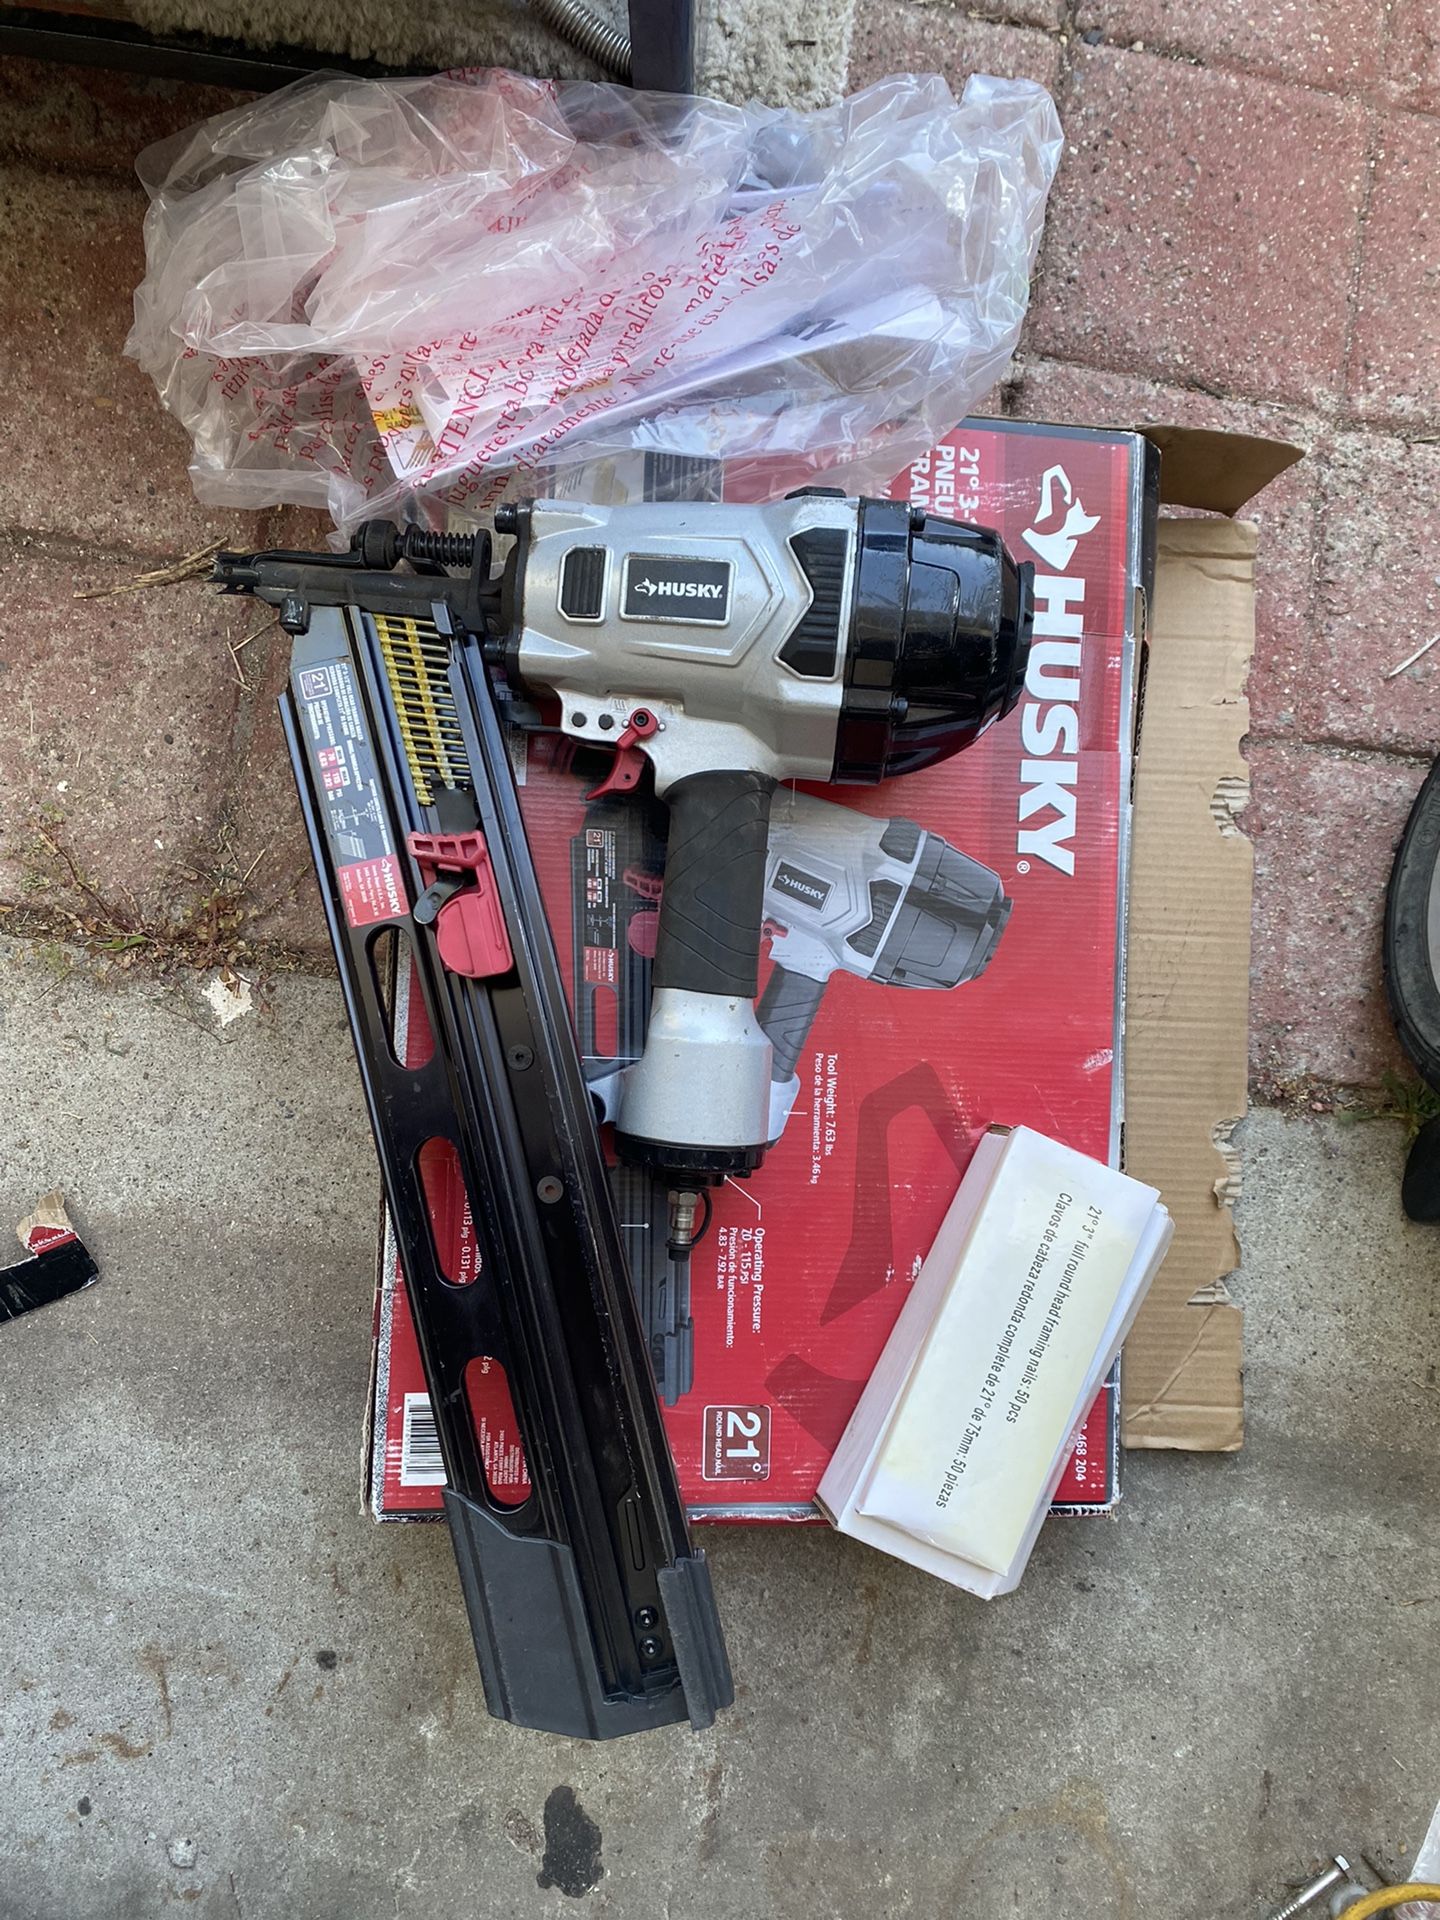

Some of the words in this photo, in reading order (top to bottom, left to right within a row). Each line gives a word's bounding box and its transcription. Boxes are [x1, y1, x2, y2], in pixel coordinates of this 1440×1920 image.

[619, 367, 656, 388] No
[959, 446, 980, 488] 21°
[934, 445, 956, 518] PNEU
[657, 581, 723, 599] HUSKY
[1017, 575, 1085, 877] HUSKY
[384, 873, 401, 913] HUSKY
[790, 879, 825, 900] HUSKY
[814, 1053, 824, 1073] Peso
[827, 1053, 838, 1075] Tool
[814, 1075, 824, 1086] de
[814, 1088, 823, 1096] la
[824, 1077, 837, 1118] Weight:
[813, 1098, 823, 1153] herramienta:
[825, 1121, 836, 1143] 7.63
[825, 1144, 833, 1155] lbs
[812, 1155, 821, 1175] 3.46
[810, 1175, 819, 1184] kg
[1048, 1193, 1073, 1229] Clavos
[1087, 1205, 1102, 1226] 21°
[719, 1226, 727, 1247] 4.83
[728, 1227, 738, 1259] Presión
[741, 1228, 752, 1241] 70
[1043, 1228, 1058, 1243] de
[461, 1246, 471, 1269] 0.131
[741, 1252, 751, 1269] 115
[751, 1227, 765, 1281] Operating
[1028, 1242, 1050, 1280] cabeza
[1071, 1240, 1089, 1261] full
[717, 1254, 727, 1273] 7.92
[728, 1262, 737, 1273] de
[740, 1269, 749, 1284] PSI
[1059, 1258, 1079, 1292] round
[726, 1275, 737, 1348] funcionamiento:
[752, 1284, 764, 1333] Pressure:
[1011, 1279, 1036, 1323] redonda
[1048, 1290, 1070, 1319] head
[991, 1323, 1018, 1373] complete
[1029, 1317, 1059, 1359] framing
[985, 1373, 1000, 1387] de
[1020, 1358, 1040, 1389] nails:
[980, 1387, 996, 1409] 21°
[1014, 1389, 1030, 1404] 50
[971, 1407, 987, 1422] de
[1006, 1401, 1022, 1424] pcs
[726, 1410, 762, 1472] 21°
[956, 1422, 982, 1459] 75mm:
[950, 1459, 966, 1474] 50
[1075, 1459, 1087, 1481] 204
[936, 1471, 959, 1508] piezas
